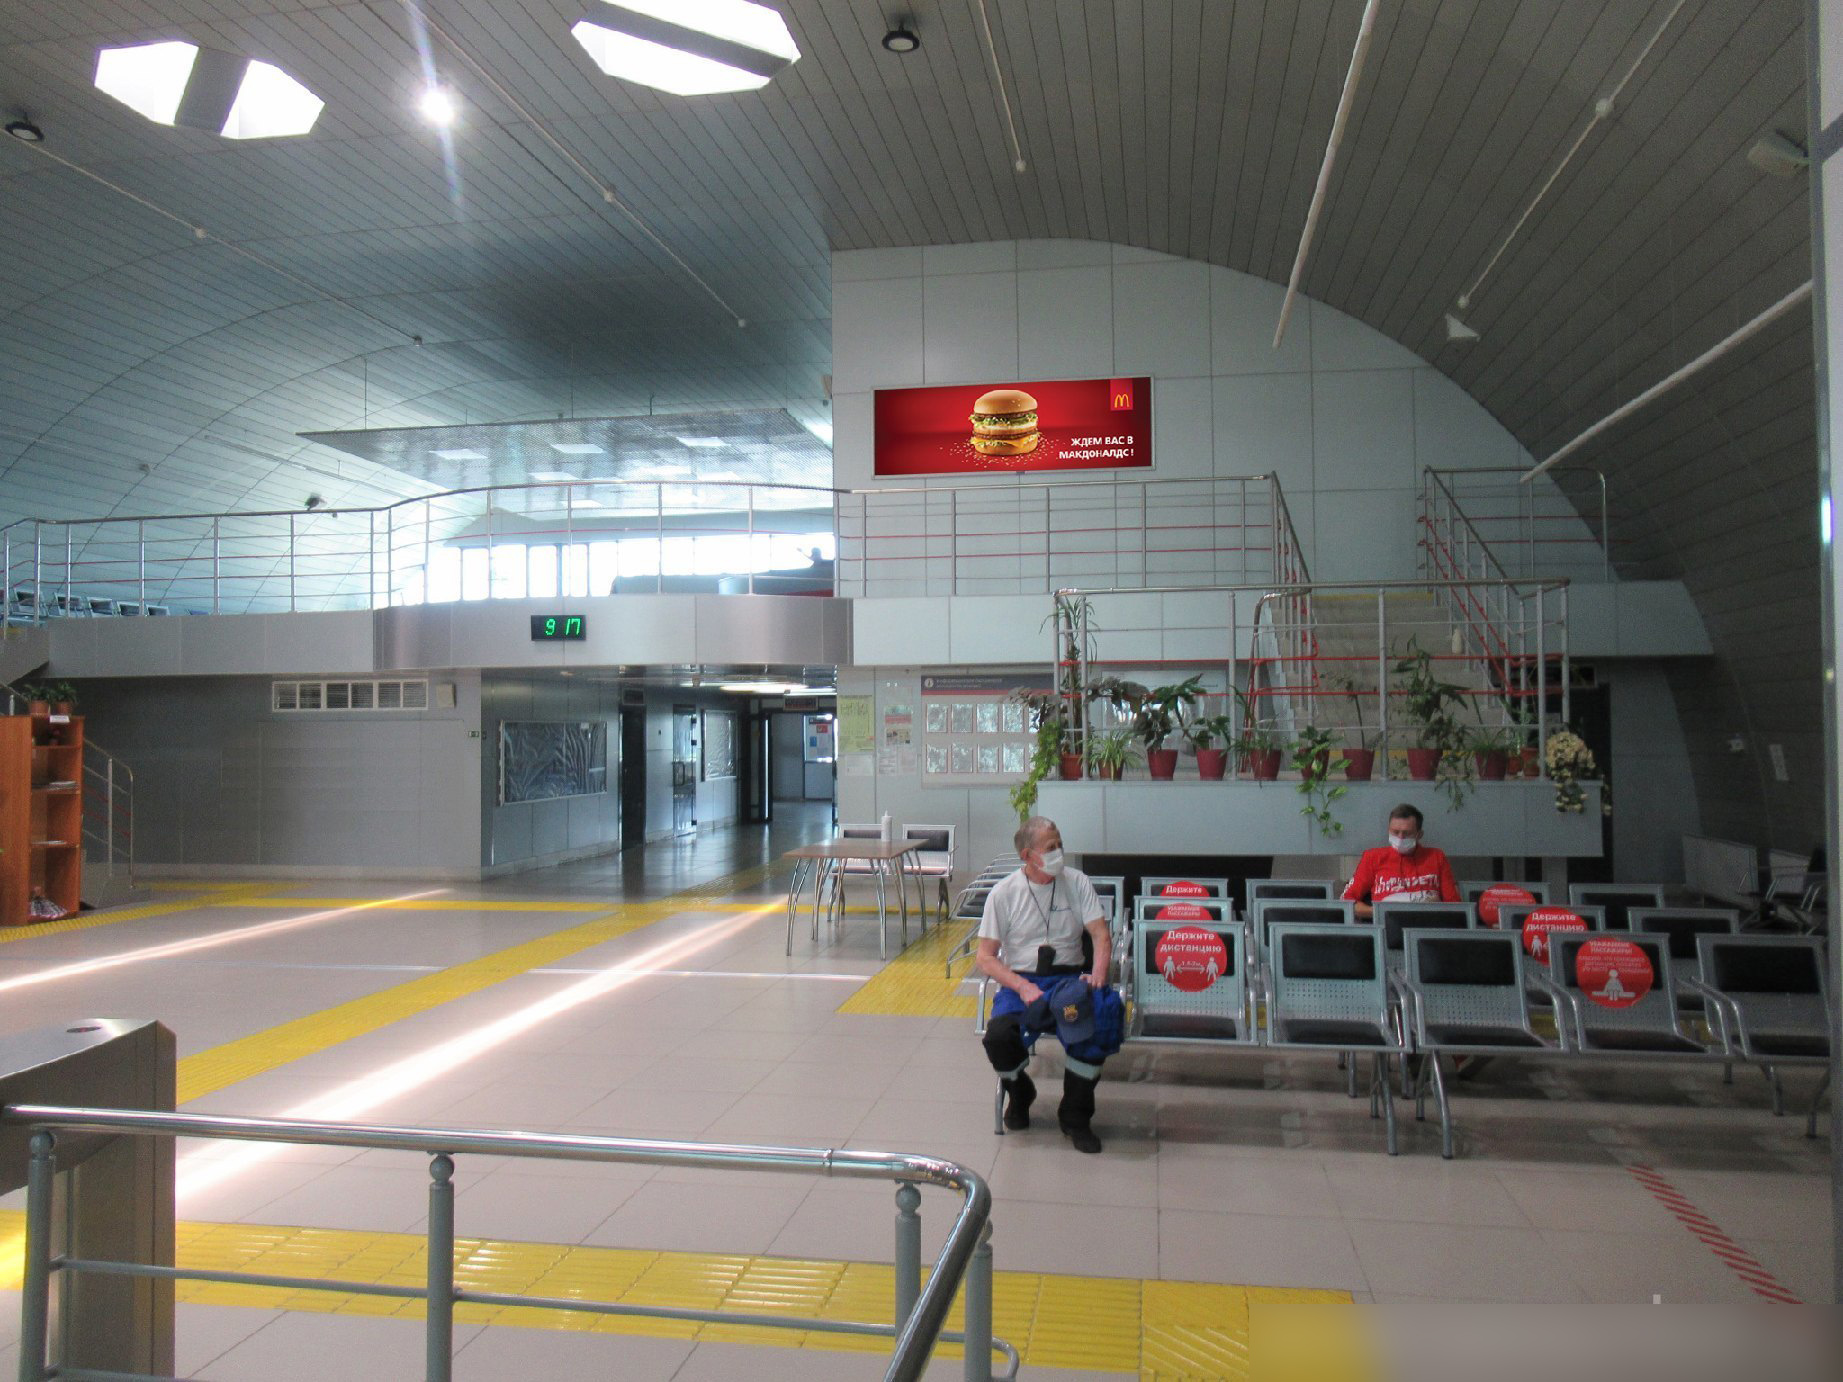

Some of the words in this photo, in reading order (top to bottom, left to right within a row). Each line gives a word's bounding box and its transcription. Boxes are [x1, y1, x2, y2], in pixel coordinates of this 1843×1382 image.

[1071, 437, 1103, 447] ЖДЕМ
[1105, 436, 1125, 445] ВАС
[1127, 436, 1134, 444] В
[1166, 885, 1203, 894] Держите
[1532, 912, 1577, 922] Держите
[1167, 930, 1215, 942] Держите
